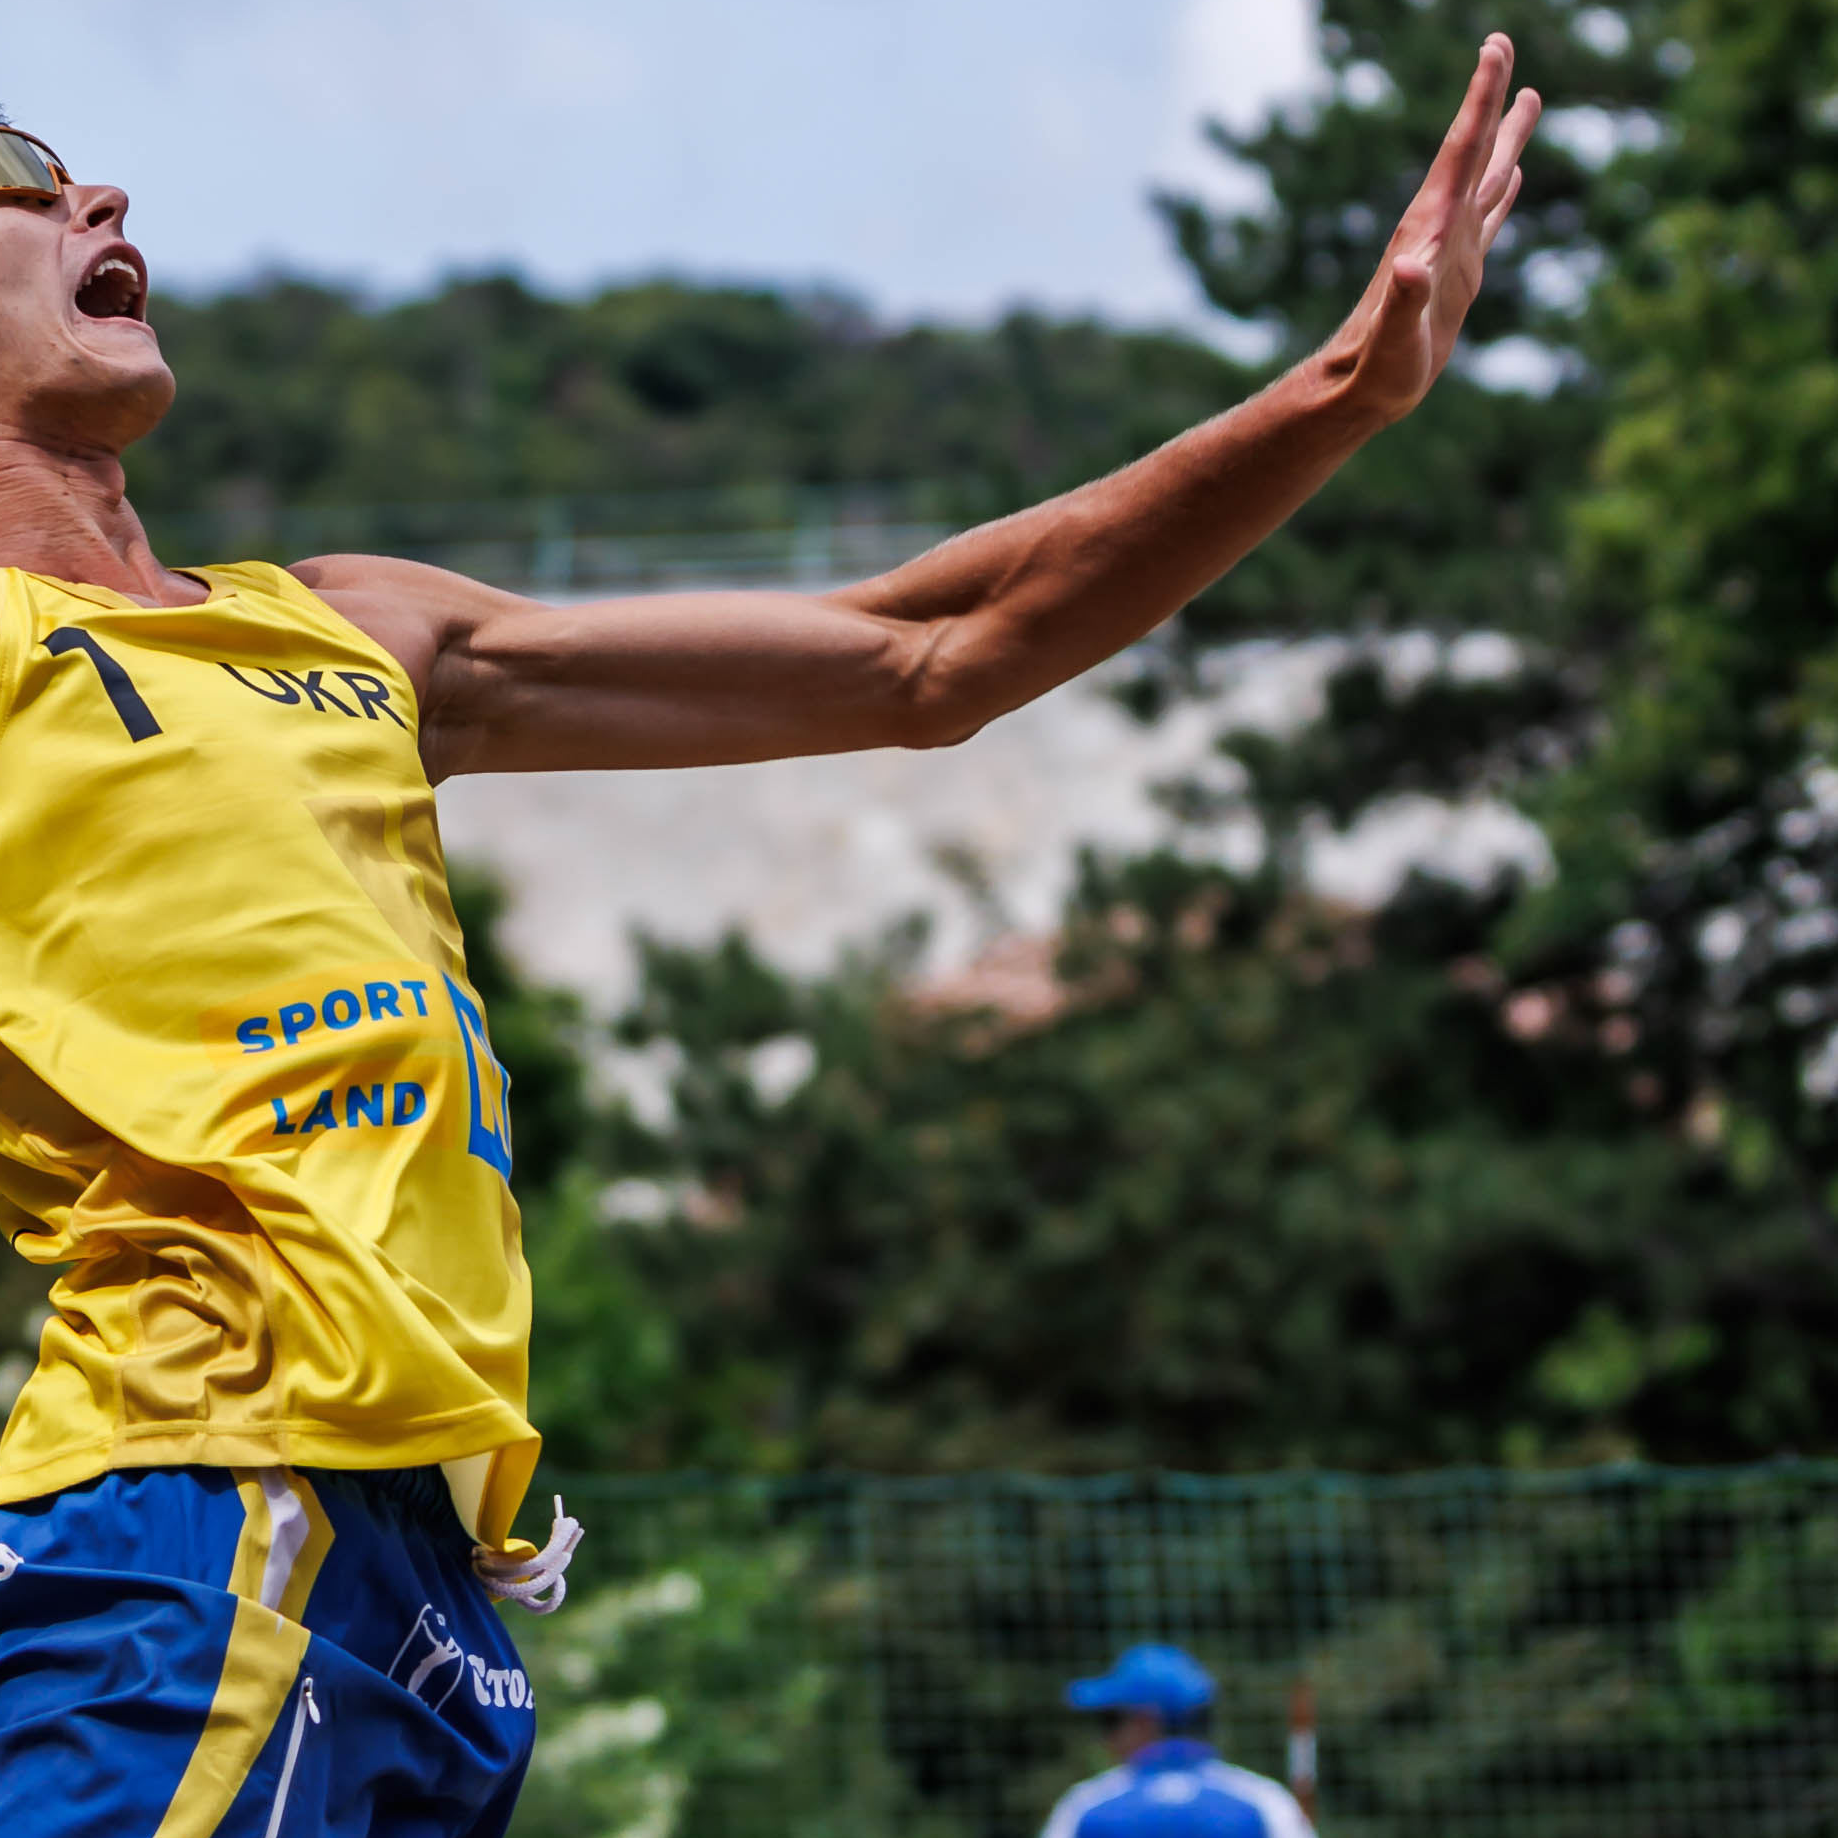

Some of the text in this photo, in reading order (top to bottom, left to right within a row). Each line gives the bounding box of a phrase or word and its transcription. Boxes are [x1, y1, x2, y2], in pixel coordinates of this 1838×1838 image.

[215, 661, 409, 731] UKR
[235, 979, 429, 1054] SPORT
[270, 1081, 428, 1136] LAND
